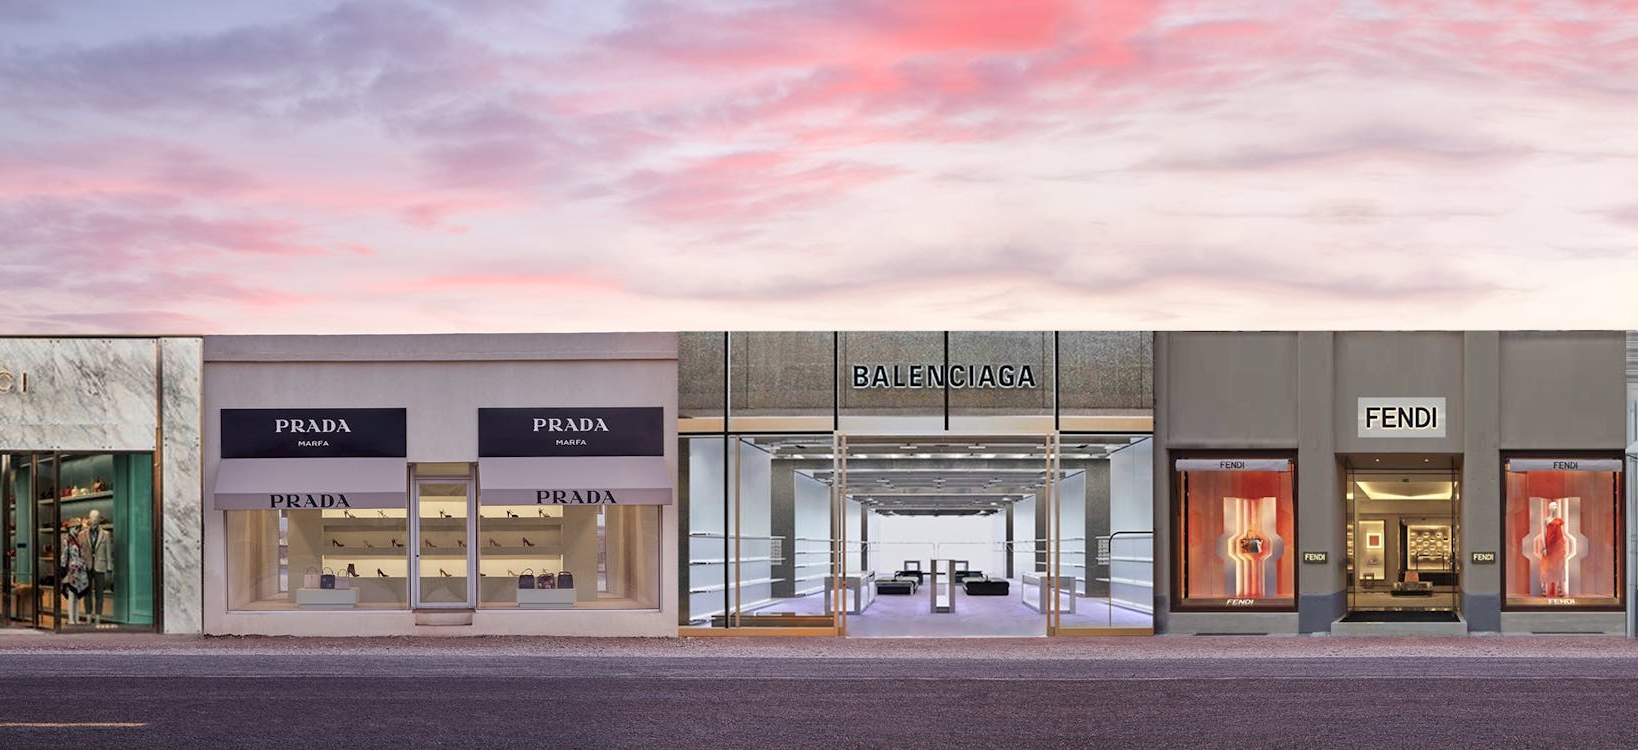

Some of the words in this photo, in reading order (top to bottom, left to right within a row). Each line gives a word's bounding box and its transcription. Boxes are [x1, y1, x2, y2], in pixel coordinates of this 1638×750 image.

[853, 364, 1035, 388] BALENCIAGA
[533, 417, 609, 432] PRADA
[1366, 407, 1437, 428] FENDI
[275, 419, 352, 433] PRADA
[1220, 461, 1245, 469] FENDI
[1553, 461, 1578, 469] FENDI
[270, 494, 352, 508] PRADA
[536, 490, 617, 504] PRADA
[1304, 553, 1325, 561] FENDI
[1473, 553, 1494, 561] FENDI
[1226, 598, 1254, 606] FENDI
